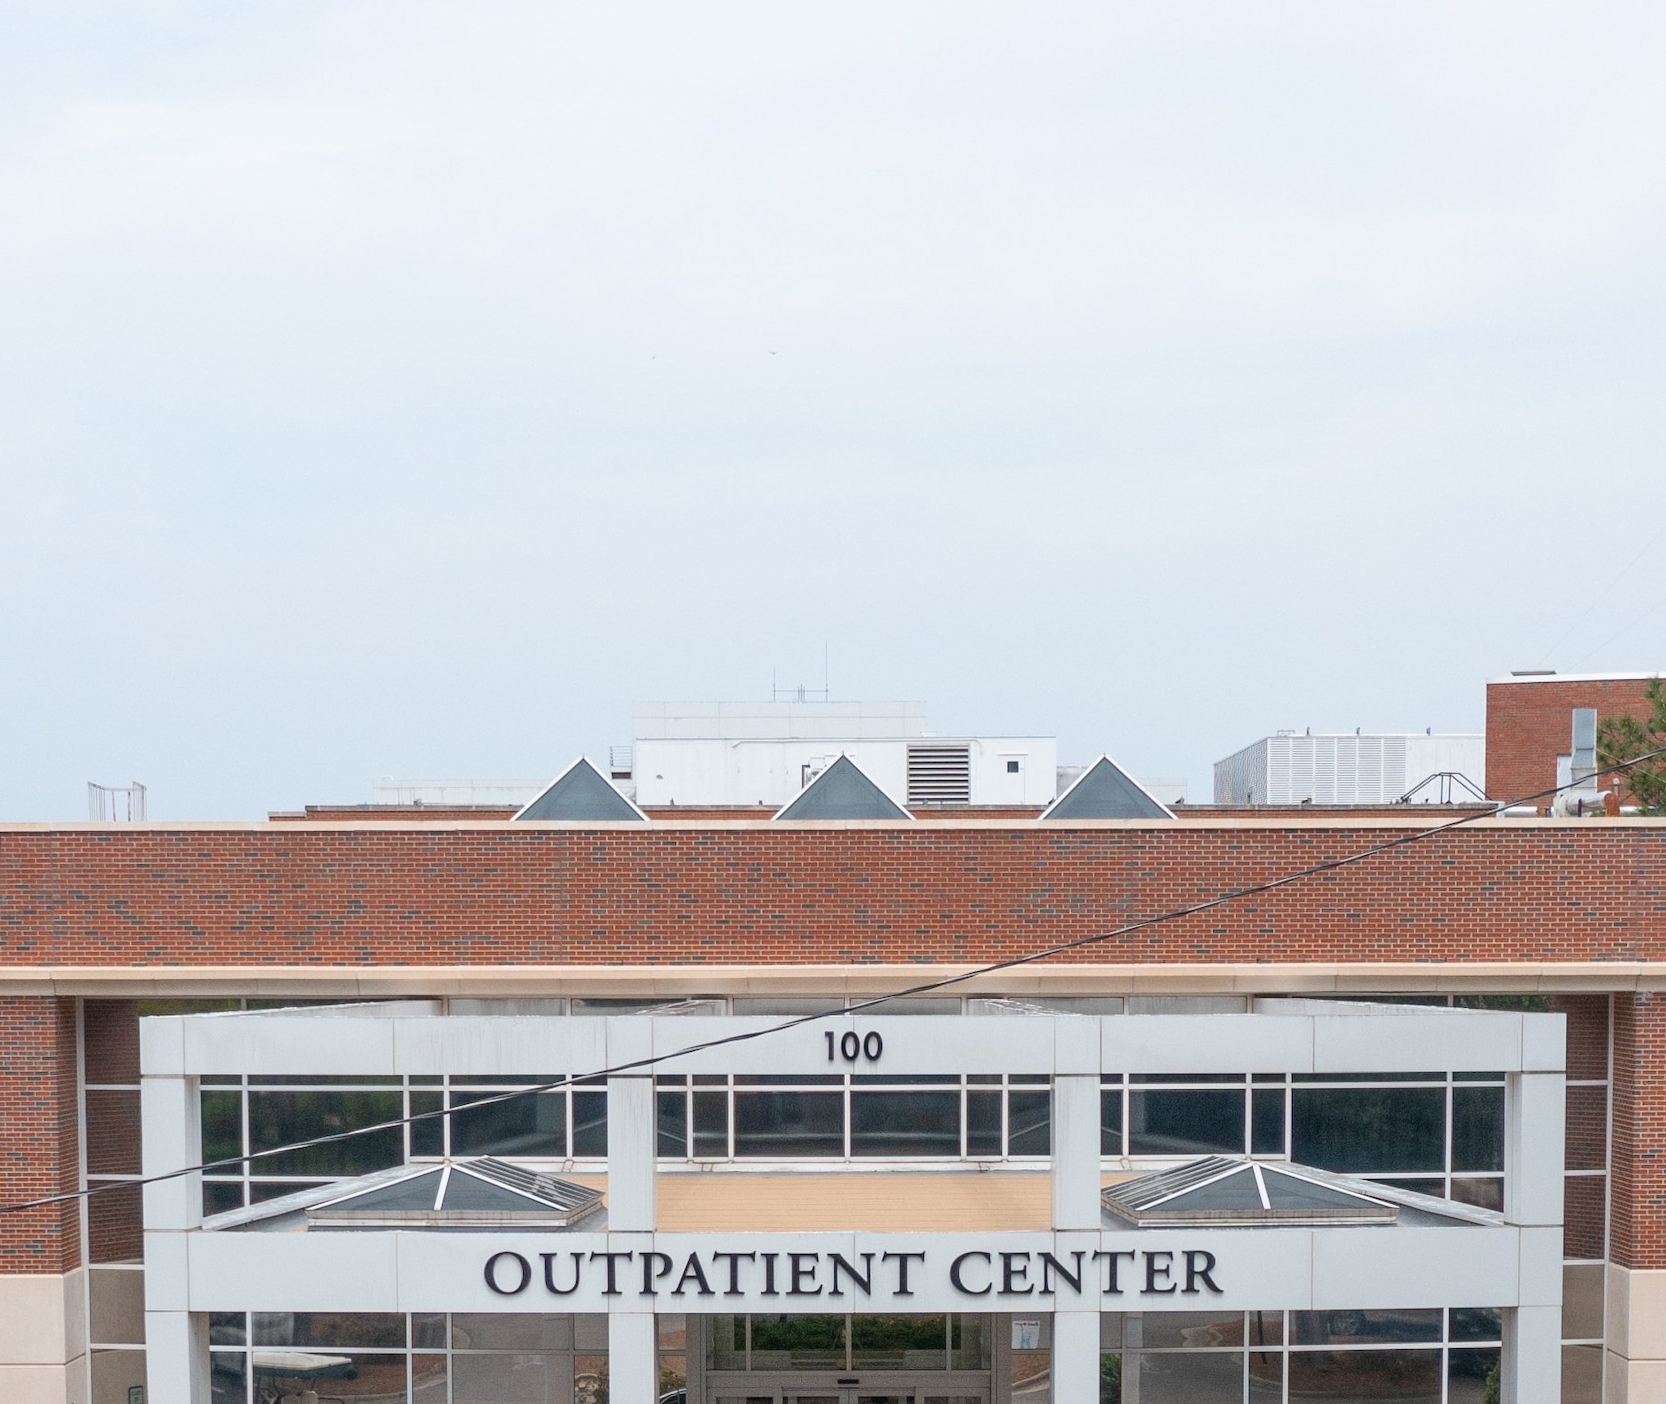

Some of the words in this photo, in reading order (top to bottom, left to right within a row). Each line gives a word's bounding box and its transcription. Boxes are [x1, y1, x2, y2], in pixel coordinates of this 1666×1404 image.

[825, 1031, 883, 1061] 100
[483, 1249, 926, 1296] OUTPATIENT
[949, 1249, 1225, 1296] CENTER
